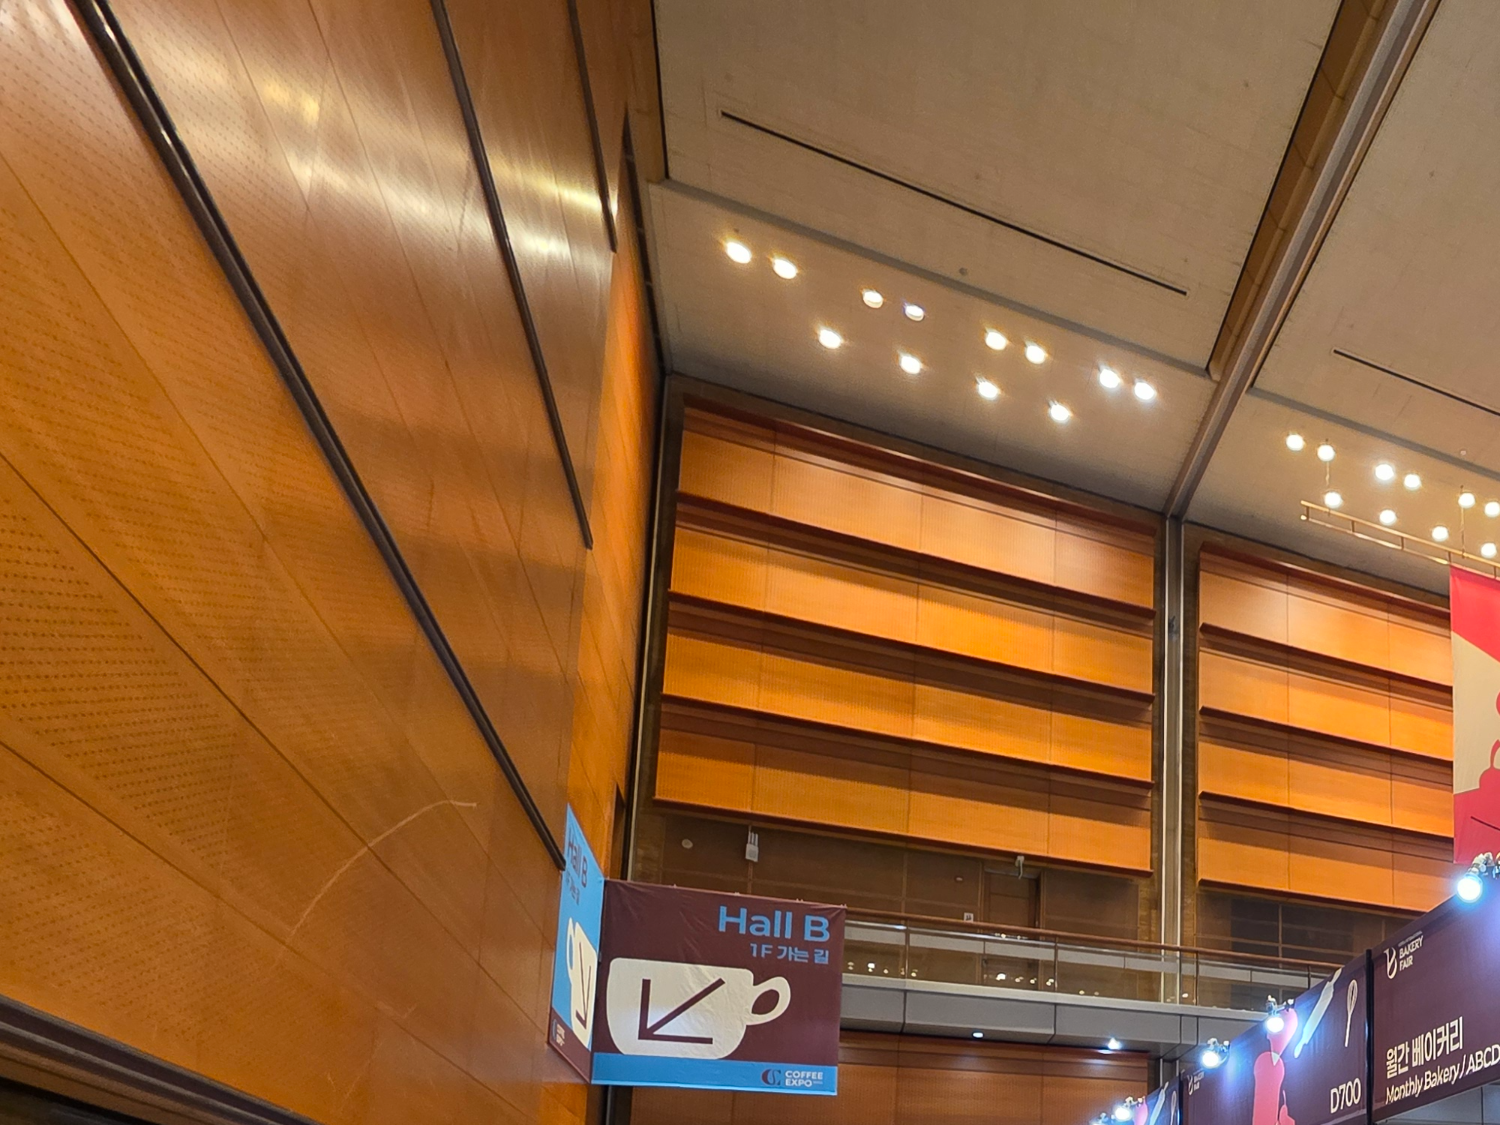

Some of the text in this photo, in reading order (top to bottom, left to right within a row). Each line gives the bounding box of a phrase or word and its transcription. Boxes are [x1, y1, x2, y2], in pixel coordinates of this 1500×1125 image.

[718, 905, 830, 942] Hall B
[750, 943, 829, 965] 1F 가는 길
[1399, 935, 1424, 959] BAKERY
[1399, 955, 1414, 971] FAIR
[1386, 1016, 1463, 1079] 월간 베이커리
[785, 1070, 824, 1080] COFFEE
[785, 1078, 813, 1087] EXPO
[1386, 1074, 1424, 1105] Monthly
[1424, 1061, 1461, 1091] Bakery
[1331, 1078, 1361, 1114] D700
